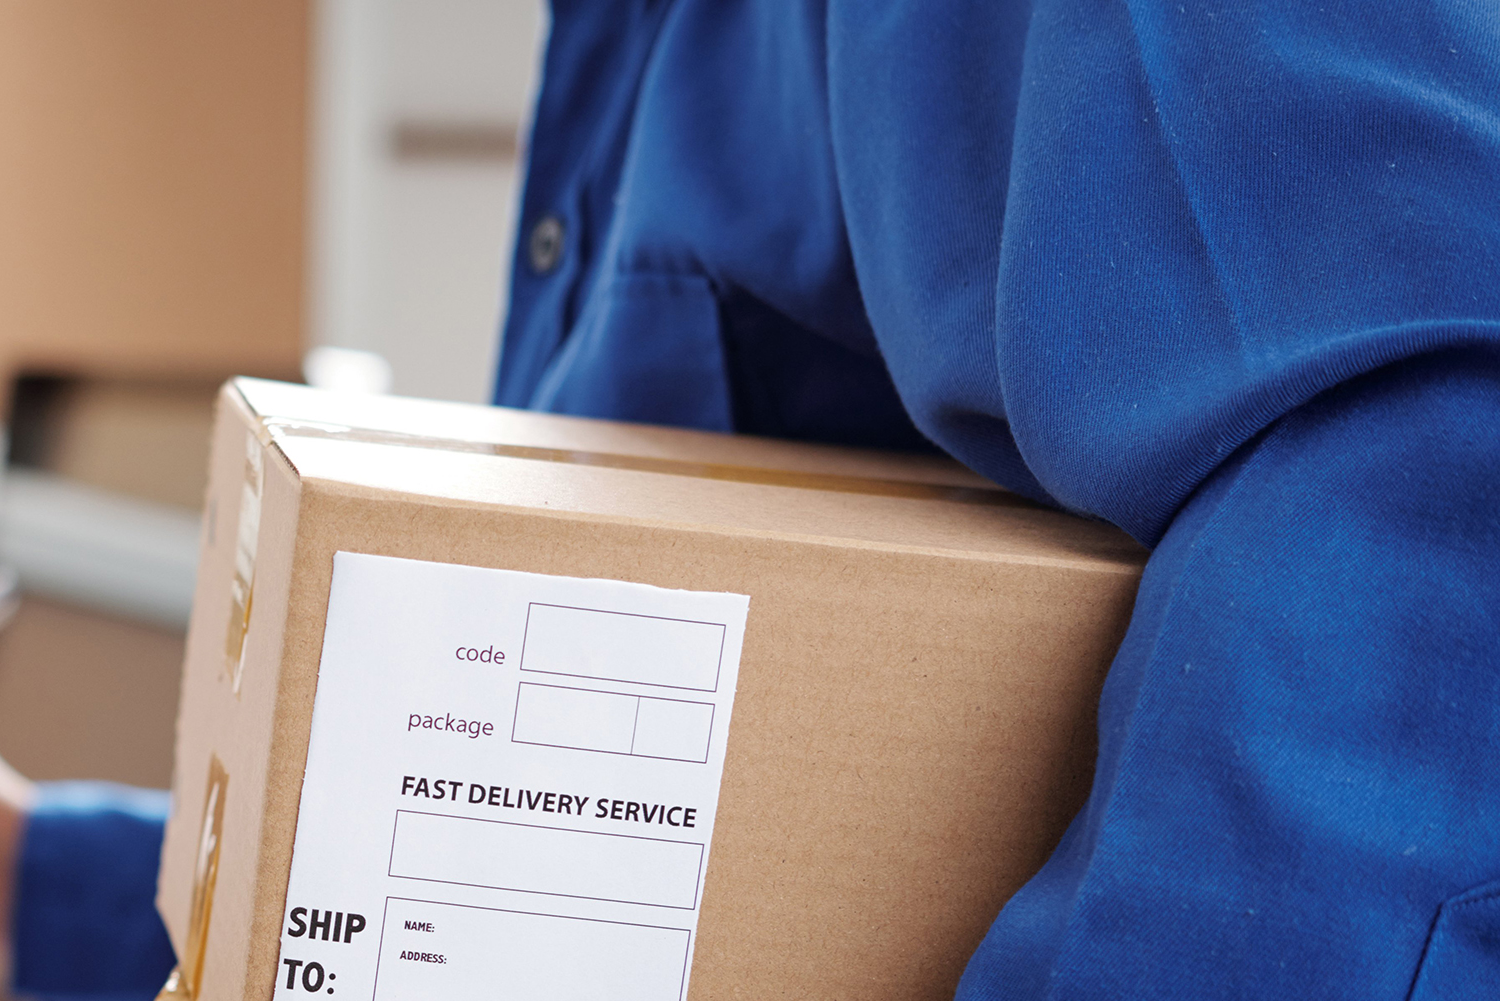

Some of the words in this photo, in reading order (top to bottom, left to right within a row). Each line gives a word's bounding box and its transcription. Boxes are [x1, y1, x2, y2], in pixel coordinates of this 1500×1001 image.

[455, 645, 506, 665] code
[407, 712, 494, 739] package
[401, 775, 464, 801] FAST
[468, 783, 590, 816] DELIVERY
[594, 798, 697, 828] SERVICE
[287, 906, 367, 944] SHIP
[404, 920, 435, 933] NAME:
[399, 950, 447, 965] ADDRESS:
[283, 958, 337, 995] TO:
